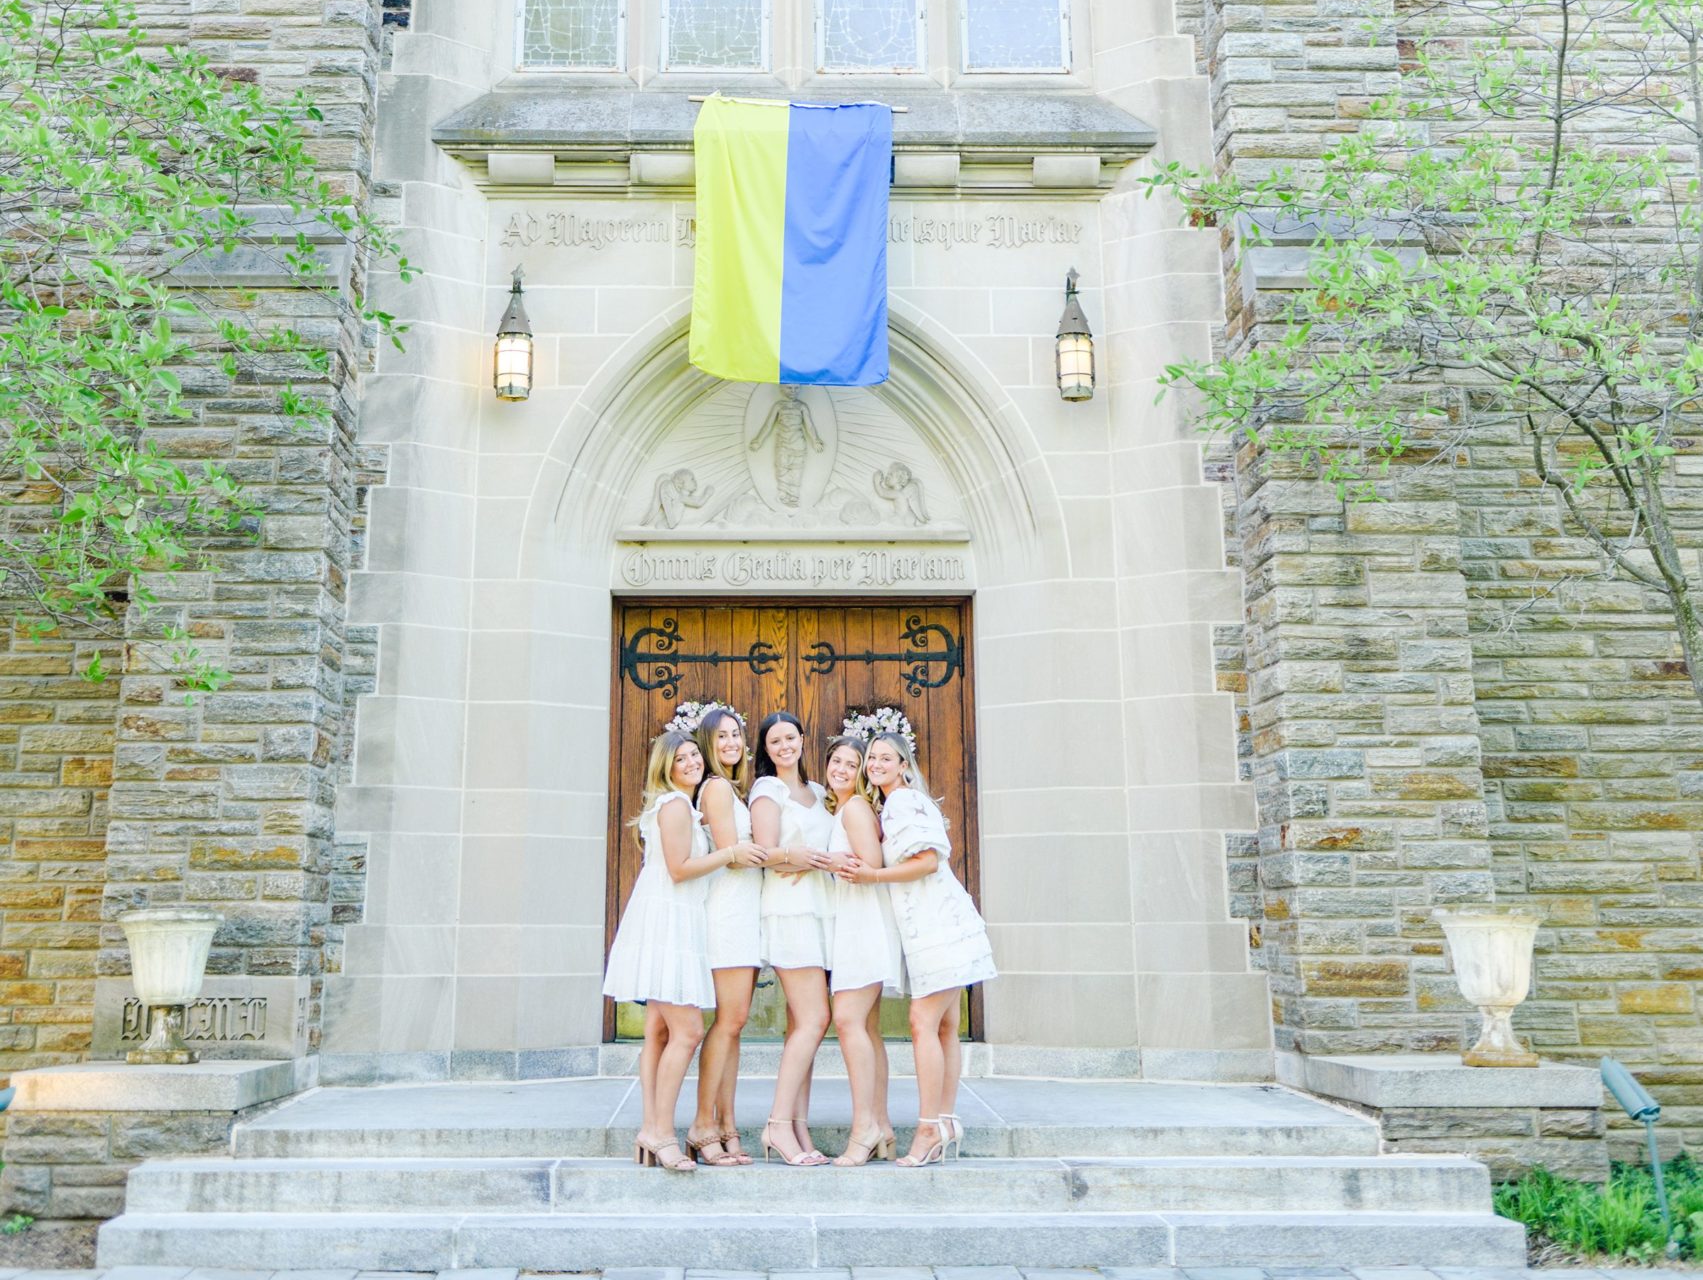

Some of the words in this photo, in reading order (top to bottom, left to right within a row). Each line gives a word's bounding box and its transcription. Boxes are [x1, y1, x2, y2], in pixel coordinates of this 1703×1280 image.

[499, 211, 541, 247] Ad
[887, 215, 982, 250] trisque
[985, 215, 1083, 248] Mariae
[622, 548, 718, 587] Omnis
[722, 551, 807, 587] Gratia
[811, 553, 855, 588] per
[858, 551, 965, 586] Mariam
